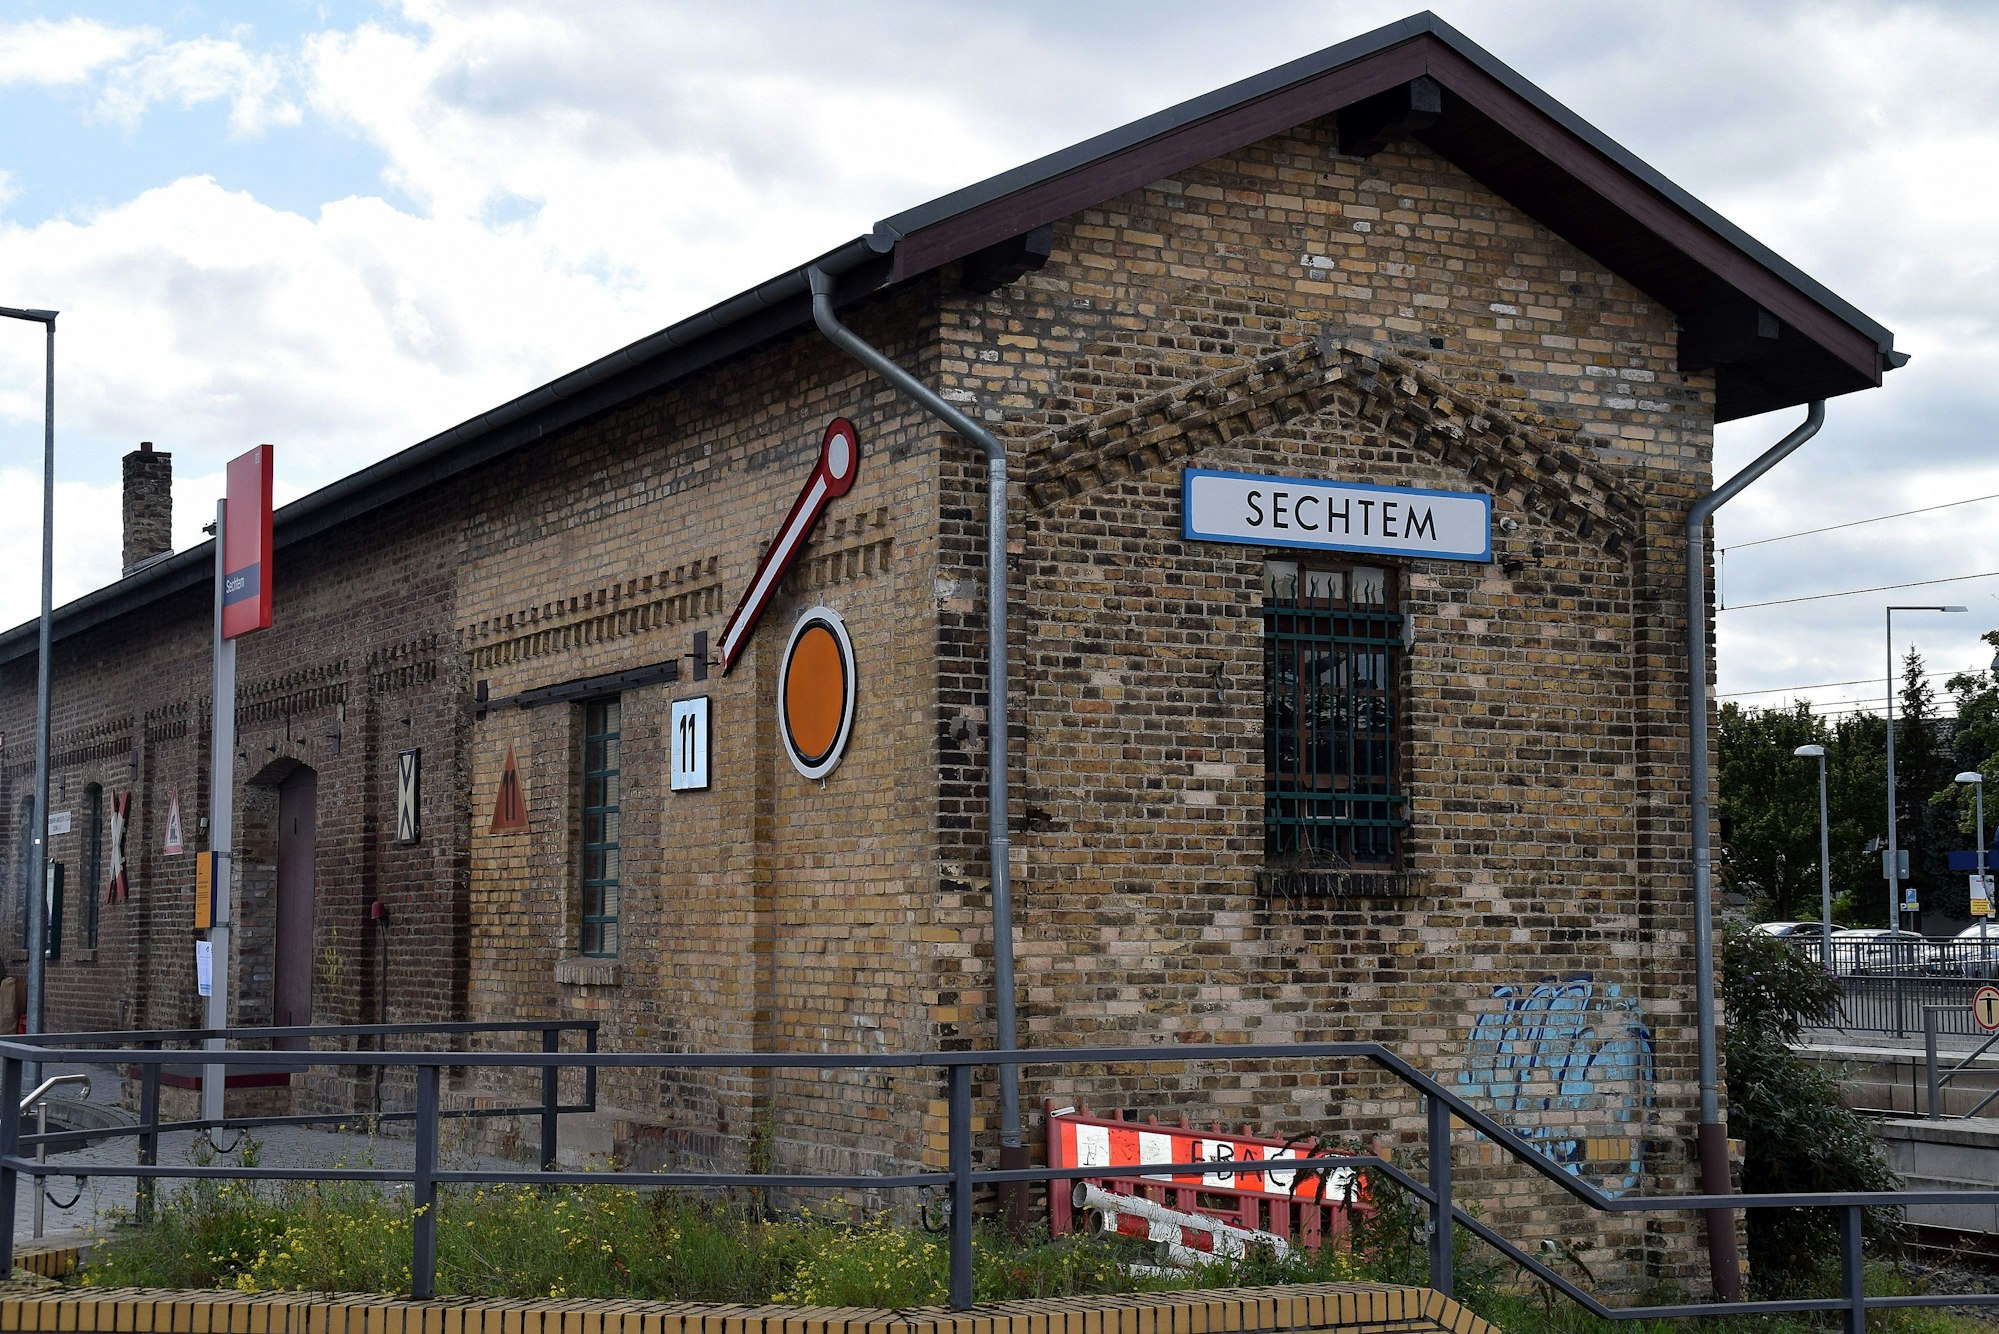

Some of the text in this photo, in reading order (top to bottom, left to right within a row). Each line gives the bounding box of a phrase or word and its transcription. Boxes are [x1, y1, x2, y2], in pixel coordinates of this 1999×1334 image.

[1246, 490, 1437, 541] SECHTEM
[226, 577, 245, 594] Sechtem
[680, 713, 696, 773] 11
[503, 769, 516, 821] 11
